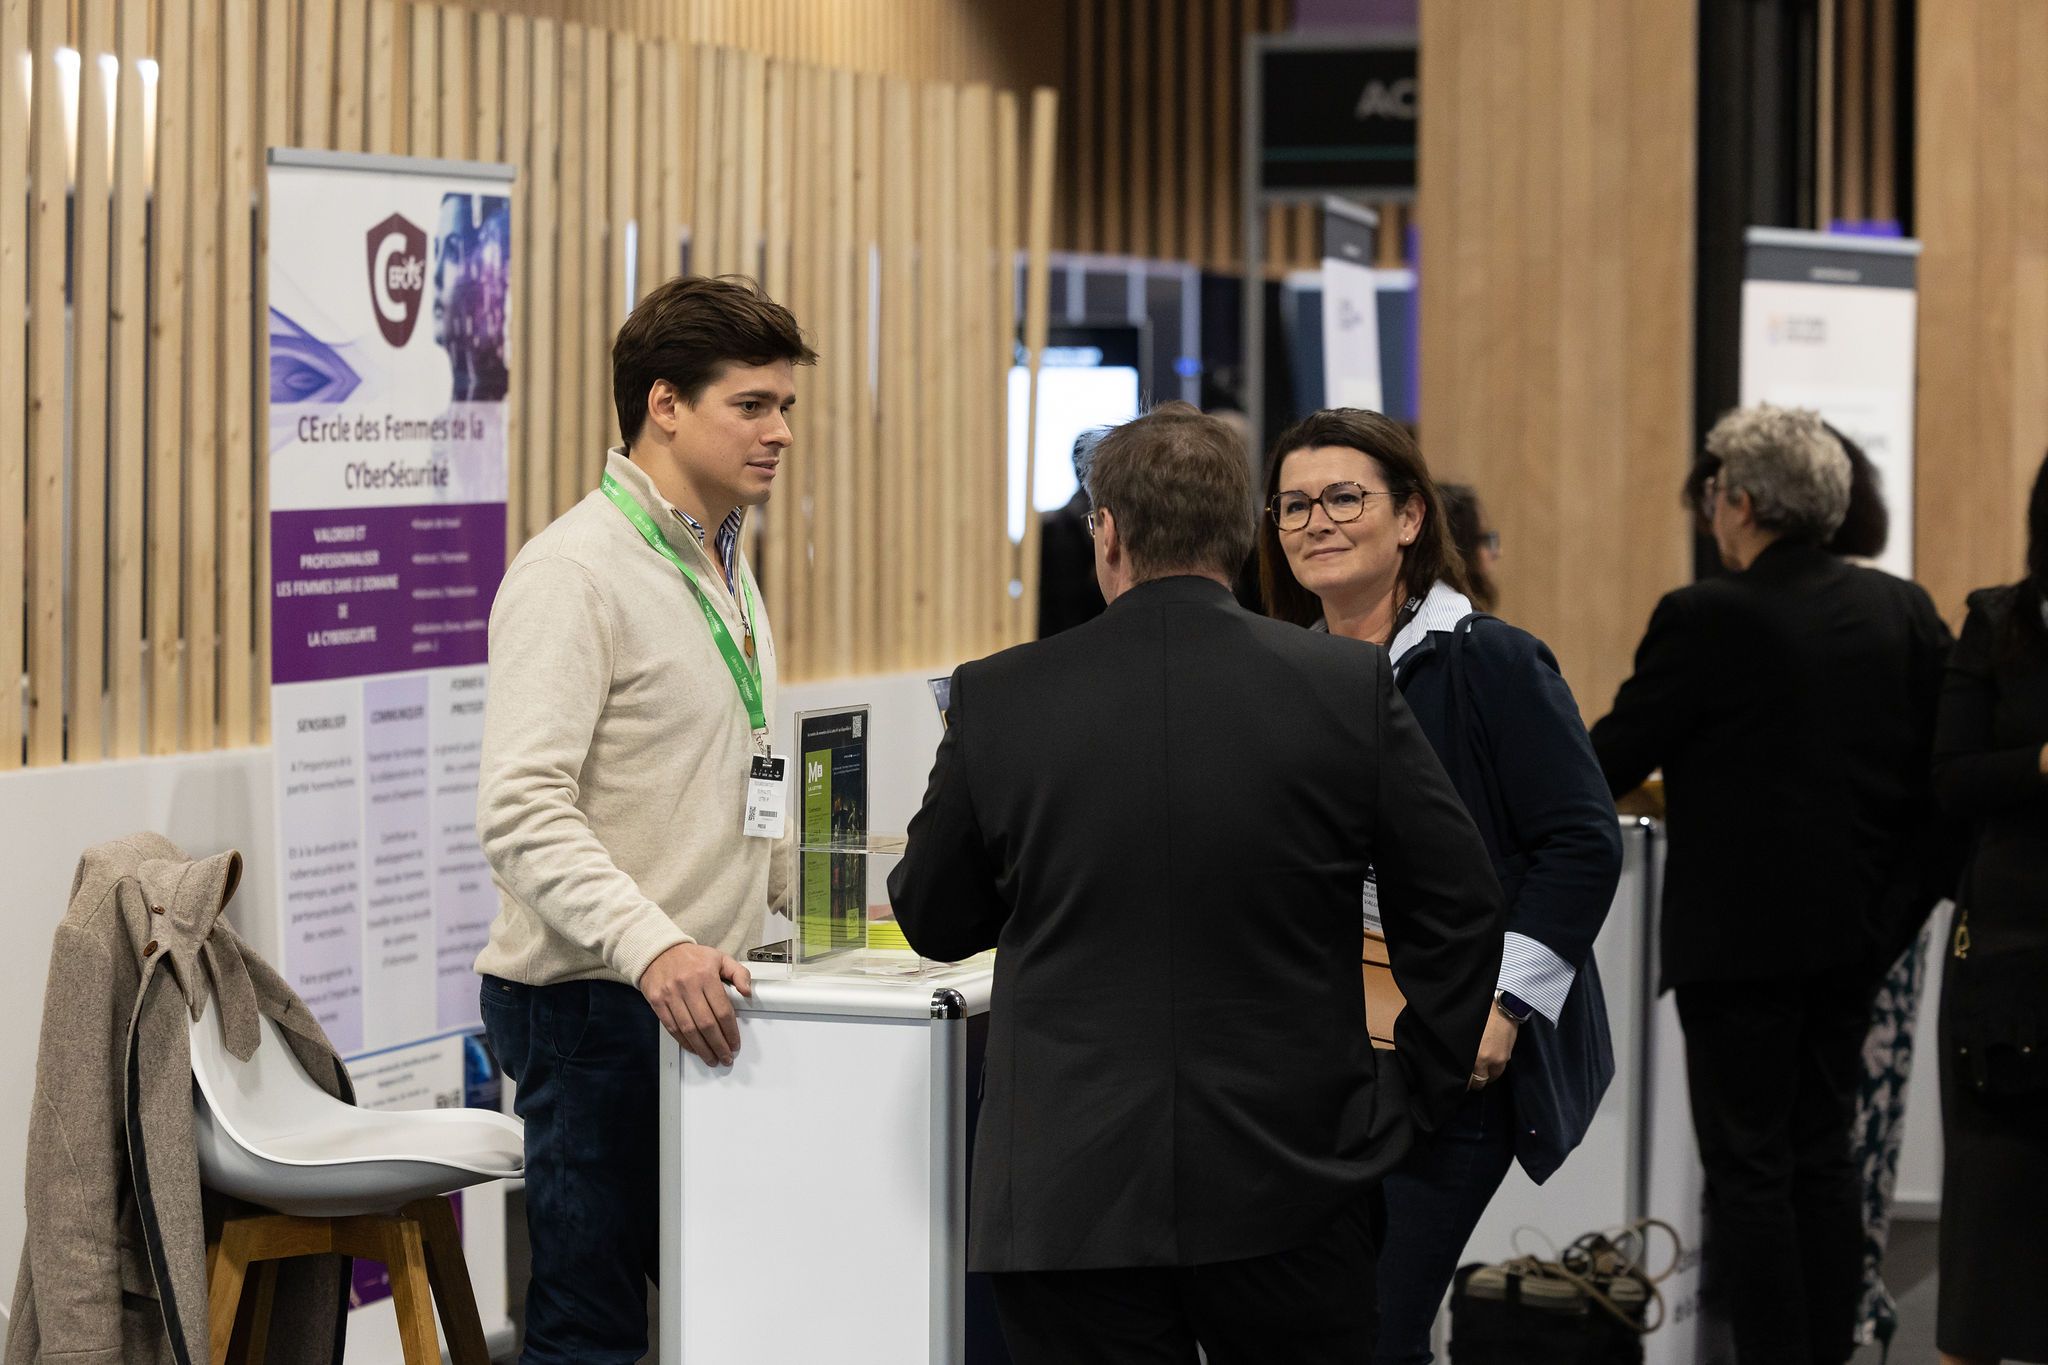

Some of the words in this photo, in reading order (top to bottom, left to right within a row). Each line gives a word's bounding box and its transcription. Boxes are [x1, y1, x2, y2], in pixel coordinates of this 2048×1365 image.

[298, 413, 350, 442] CErcle
[355, 413, 380, 441] des
[384, 413, 449, 441] Femmes
